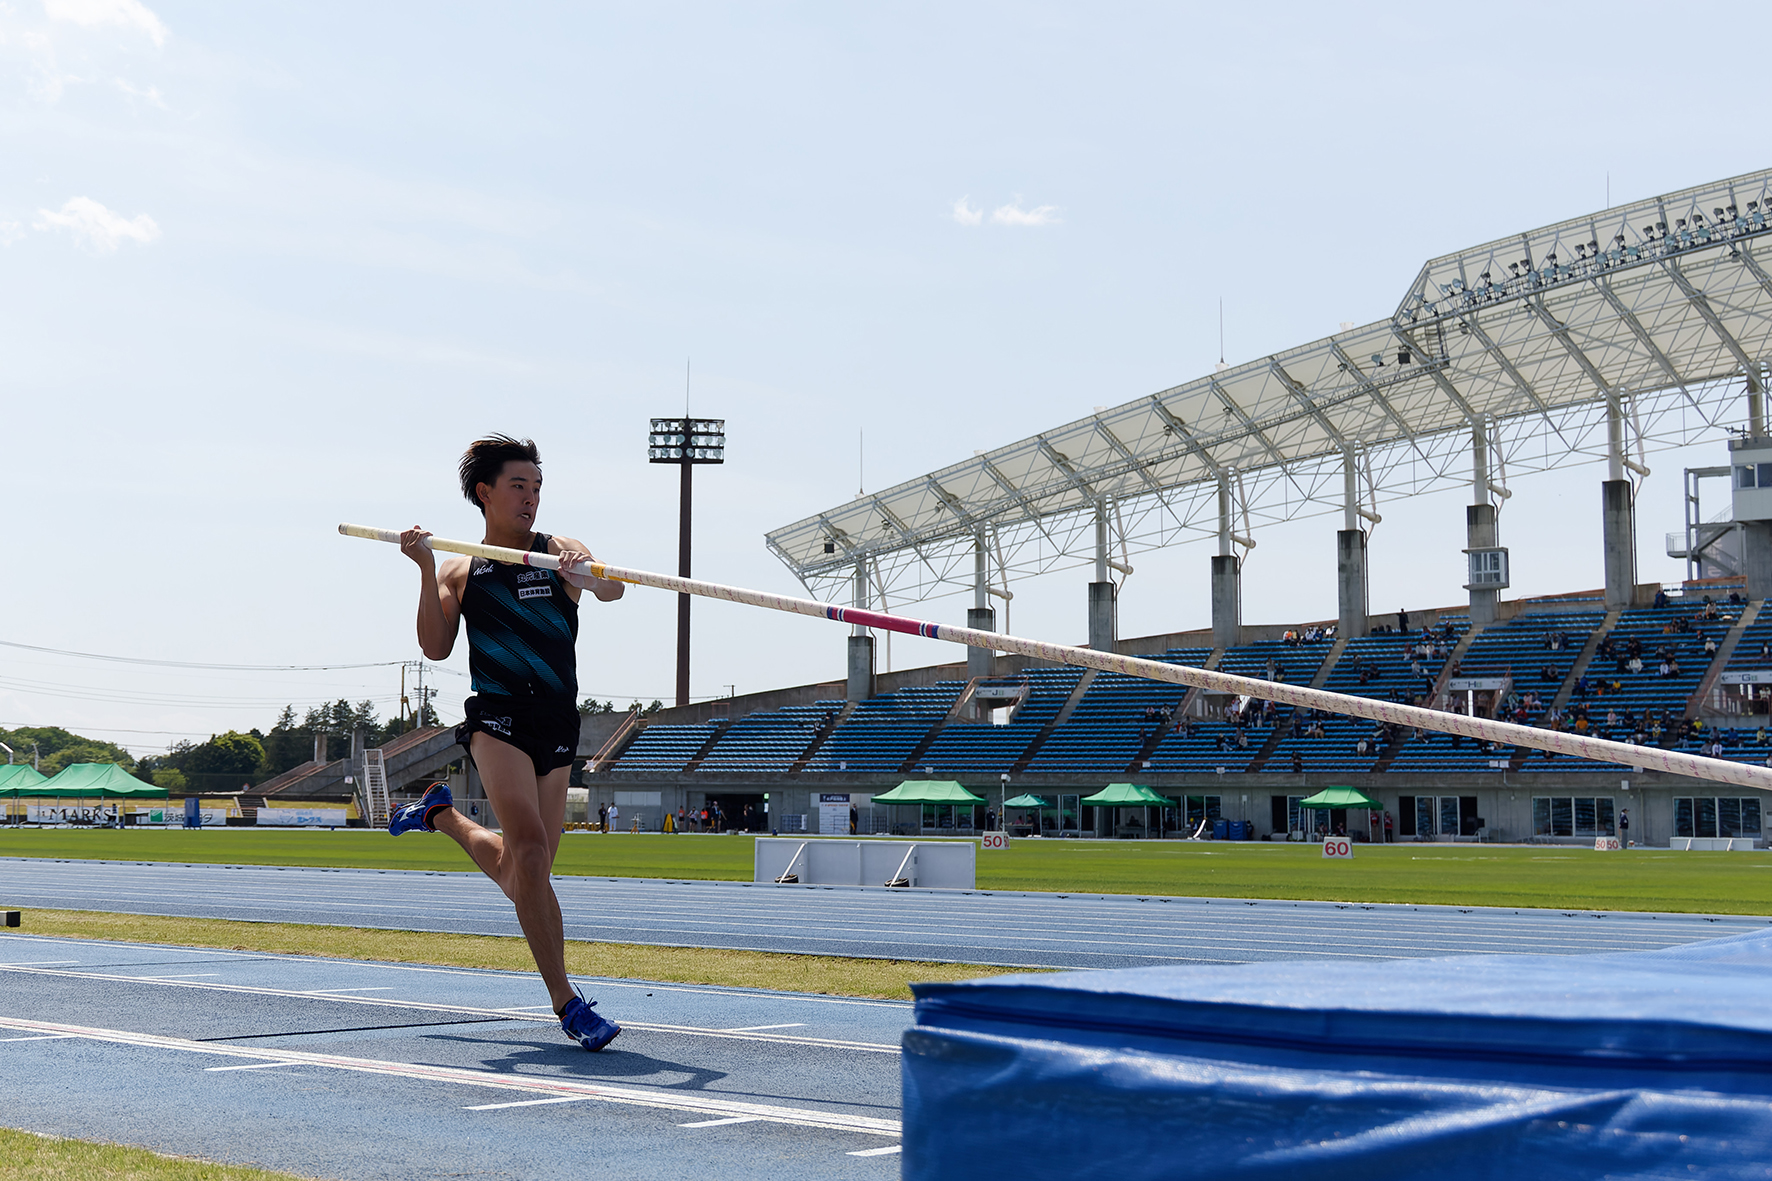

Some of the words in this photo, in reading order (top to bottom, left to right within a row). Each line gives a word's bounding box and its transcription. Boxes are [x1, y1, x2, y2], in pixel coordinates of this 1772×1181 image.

[983, 835, 1002, 848] 50
[1596, 840, 1606, 849] 50
[1607, 840, 1619, 850] 50
[1325, 841, 1349, 856] 60
